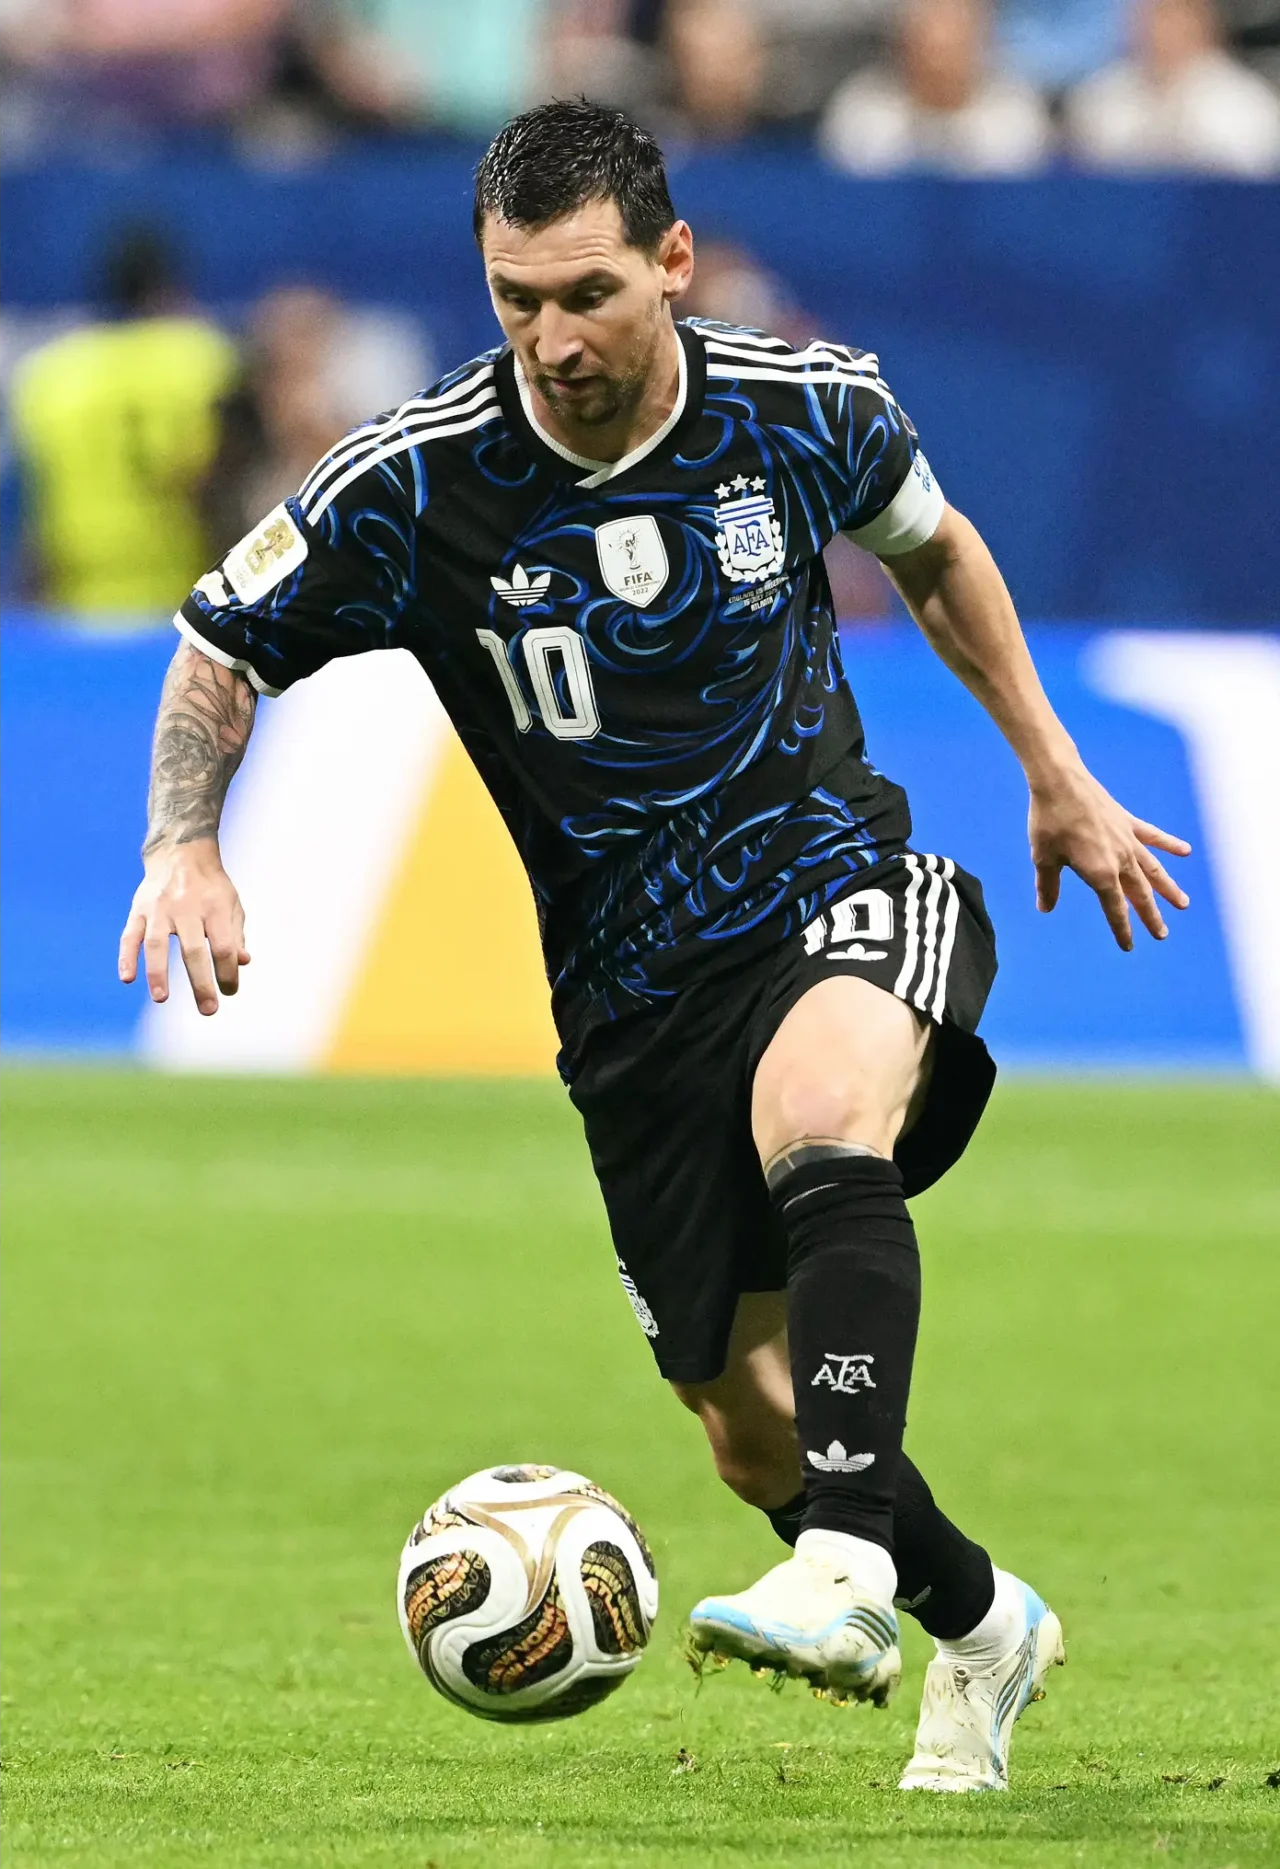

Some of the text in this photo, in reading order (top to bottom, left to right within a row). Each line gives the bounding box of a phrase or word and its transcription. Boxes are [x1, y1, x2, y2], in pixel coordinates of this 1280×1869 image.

[733, 519, 772, 557] AFA
[624, 571, 653, 586] FIFA
[632, 587, 649, 596] 2022
[475, 626, 602, 741] 10
[800, 888, 894, 956] 10
[811, 1352, 877, 1394] AFA
